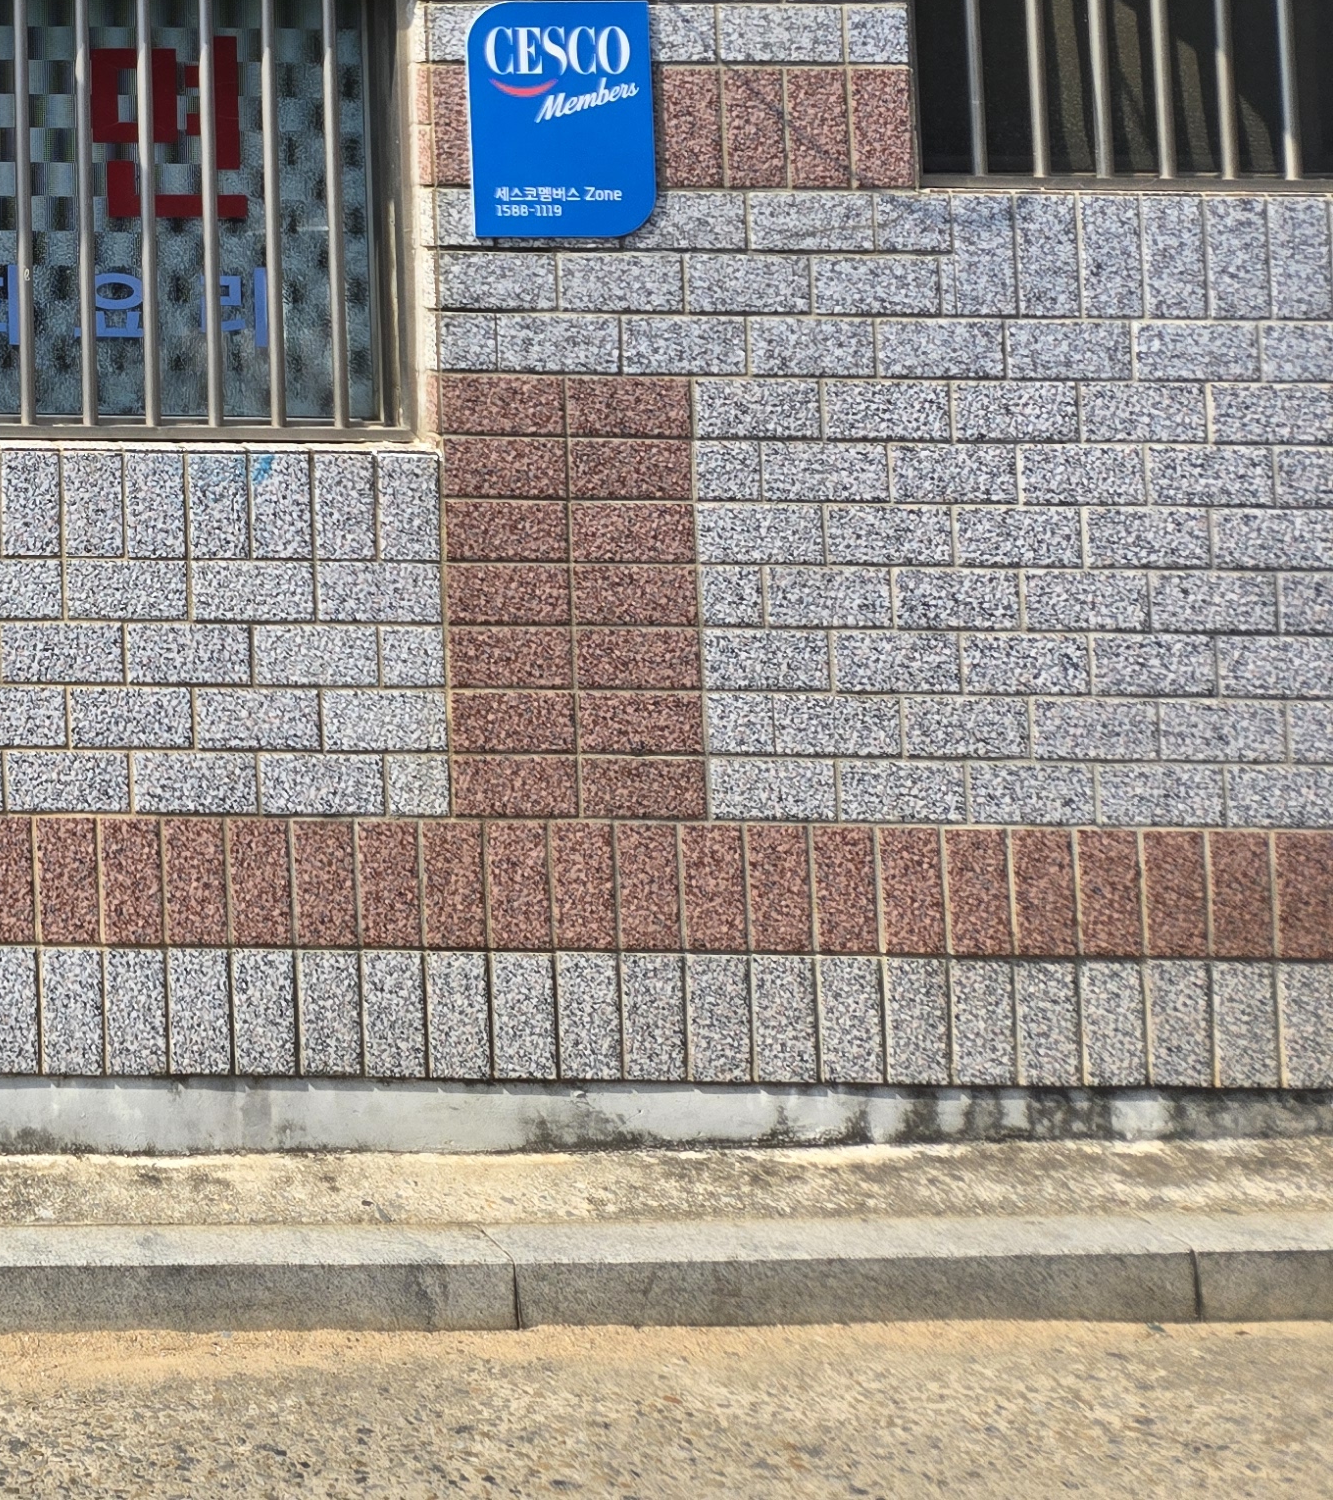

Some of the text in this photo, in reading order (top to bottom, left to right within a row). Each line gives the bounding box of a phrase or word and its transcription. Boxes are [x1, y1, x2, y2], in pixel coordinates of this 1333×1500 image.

[484, 25, 631, 76] CESCO
[534, 77, 640, 124] Members
[495, 186, 623, 202] 세스코멤버스 Zone
[496, 204, 563, 217] 1588-1119
